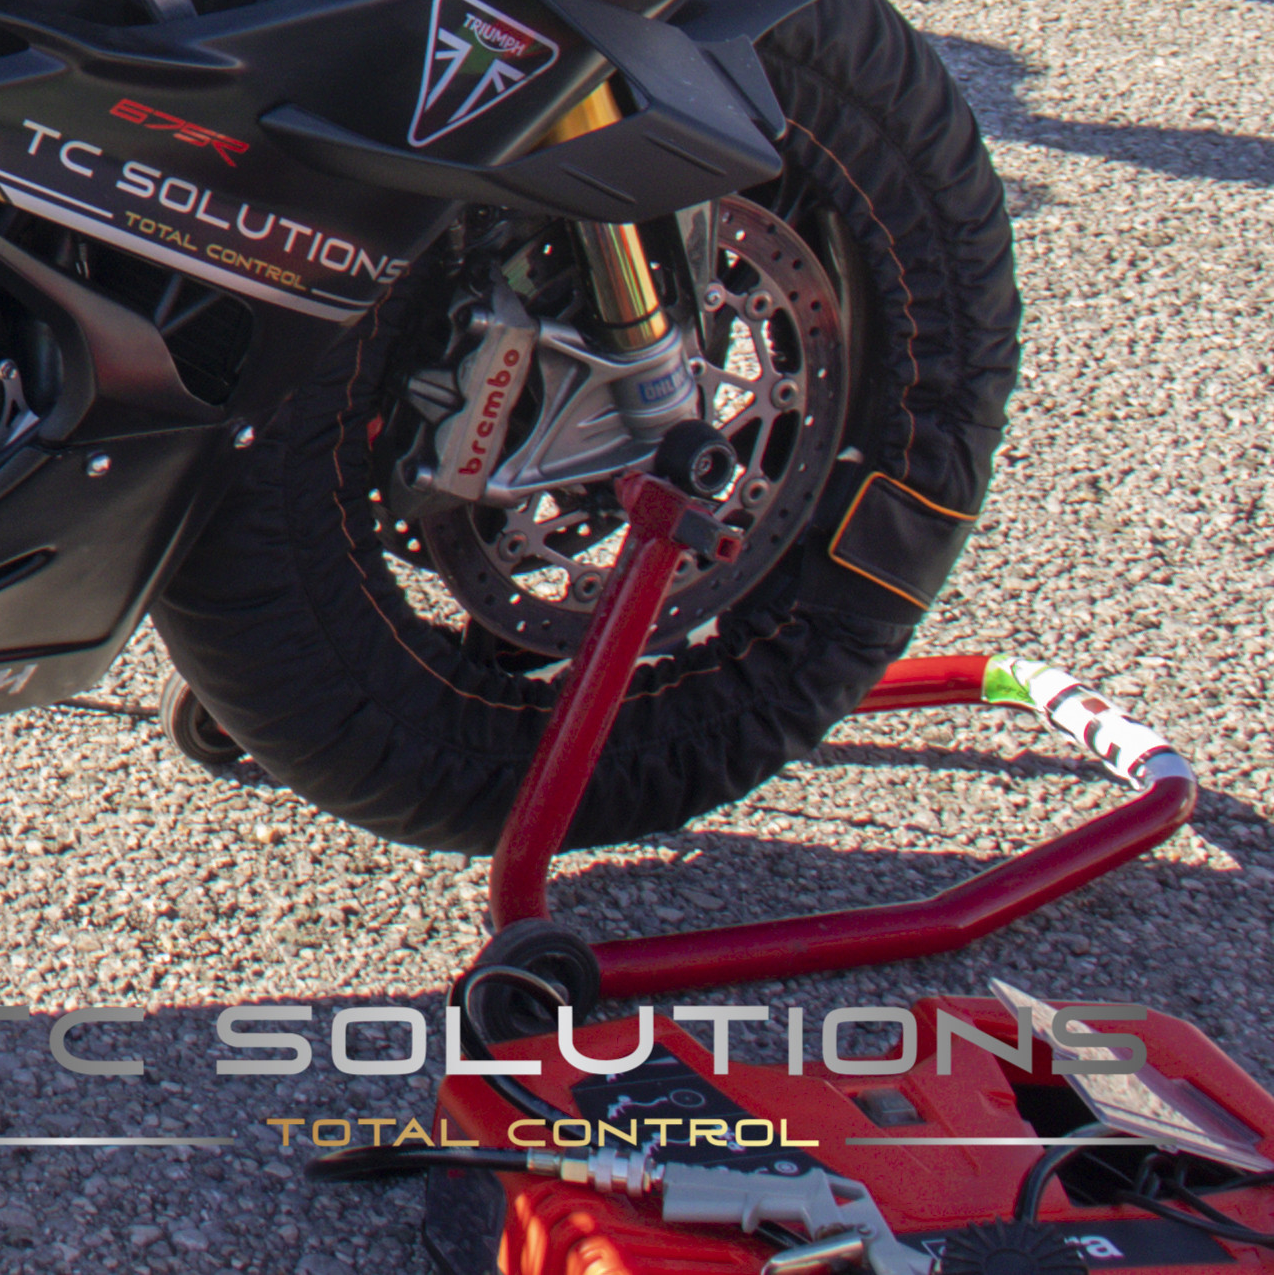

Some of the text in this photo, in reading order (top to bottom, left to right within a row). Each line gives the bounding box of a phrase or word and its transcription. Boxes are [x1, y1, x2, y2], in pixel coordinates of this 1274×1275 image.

[462, 11, 526, 58] TRIUMPH
[108, 97, 250, 168] 675R
[22, 118, 410, 285] TC SOLUTIONS
[125, 210, 308, 292] TOTAL CONTROL
[457, 348, 520, 476] brembo
